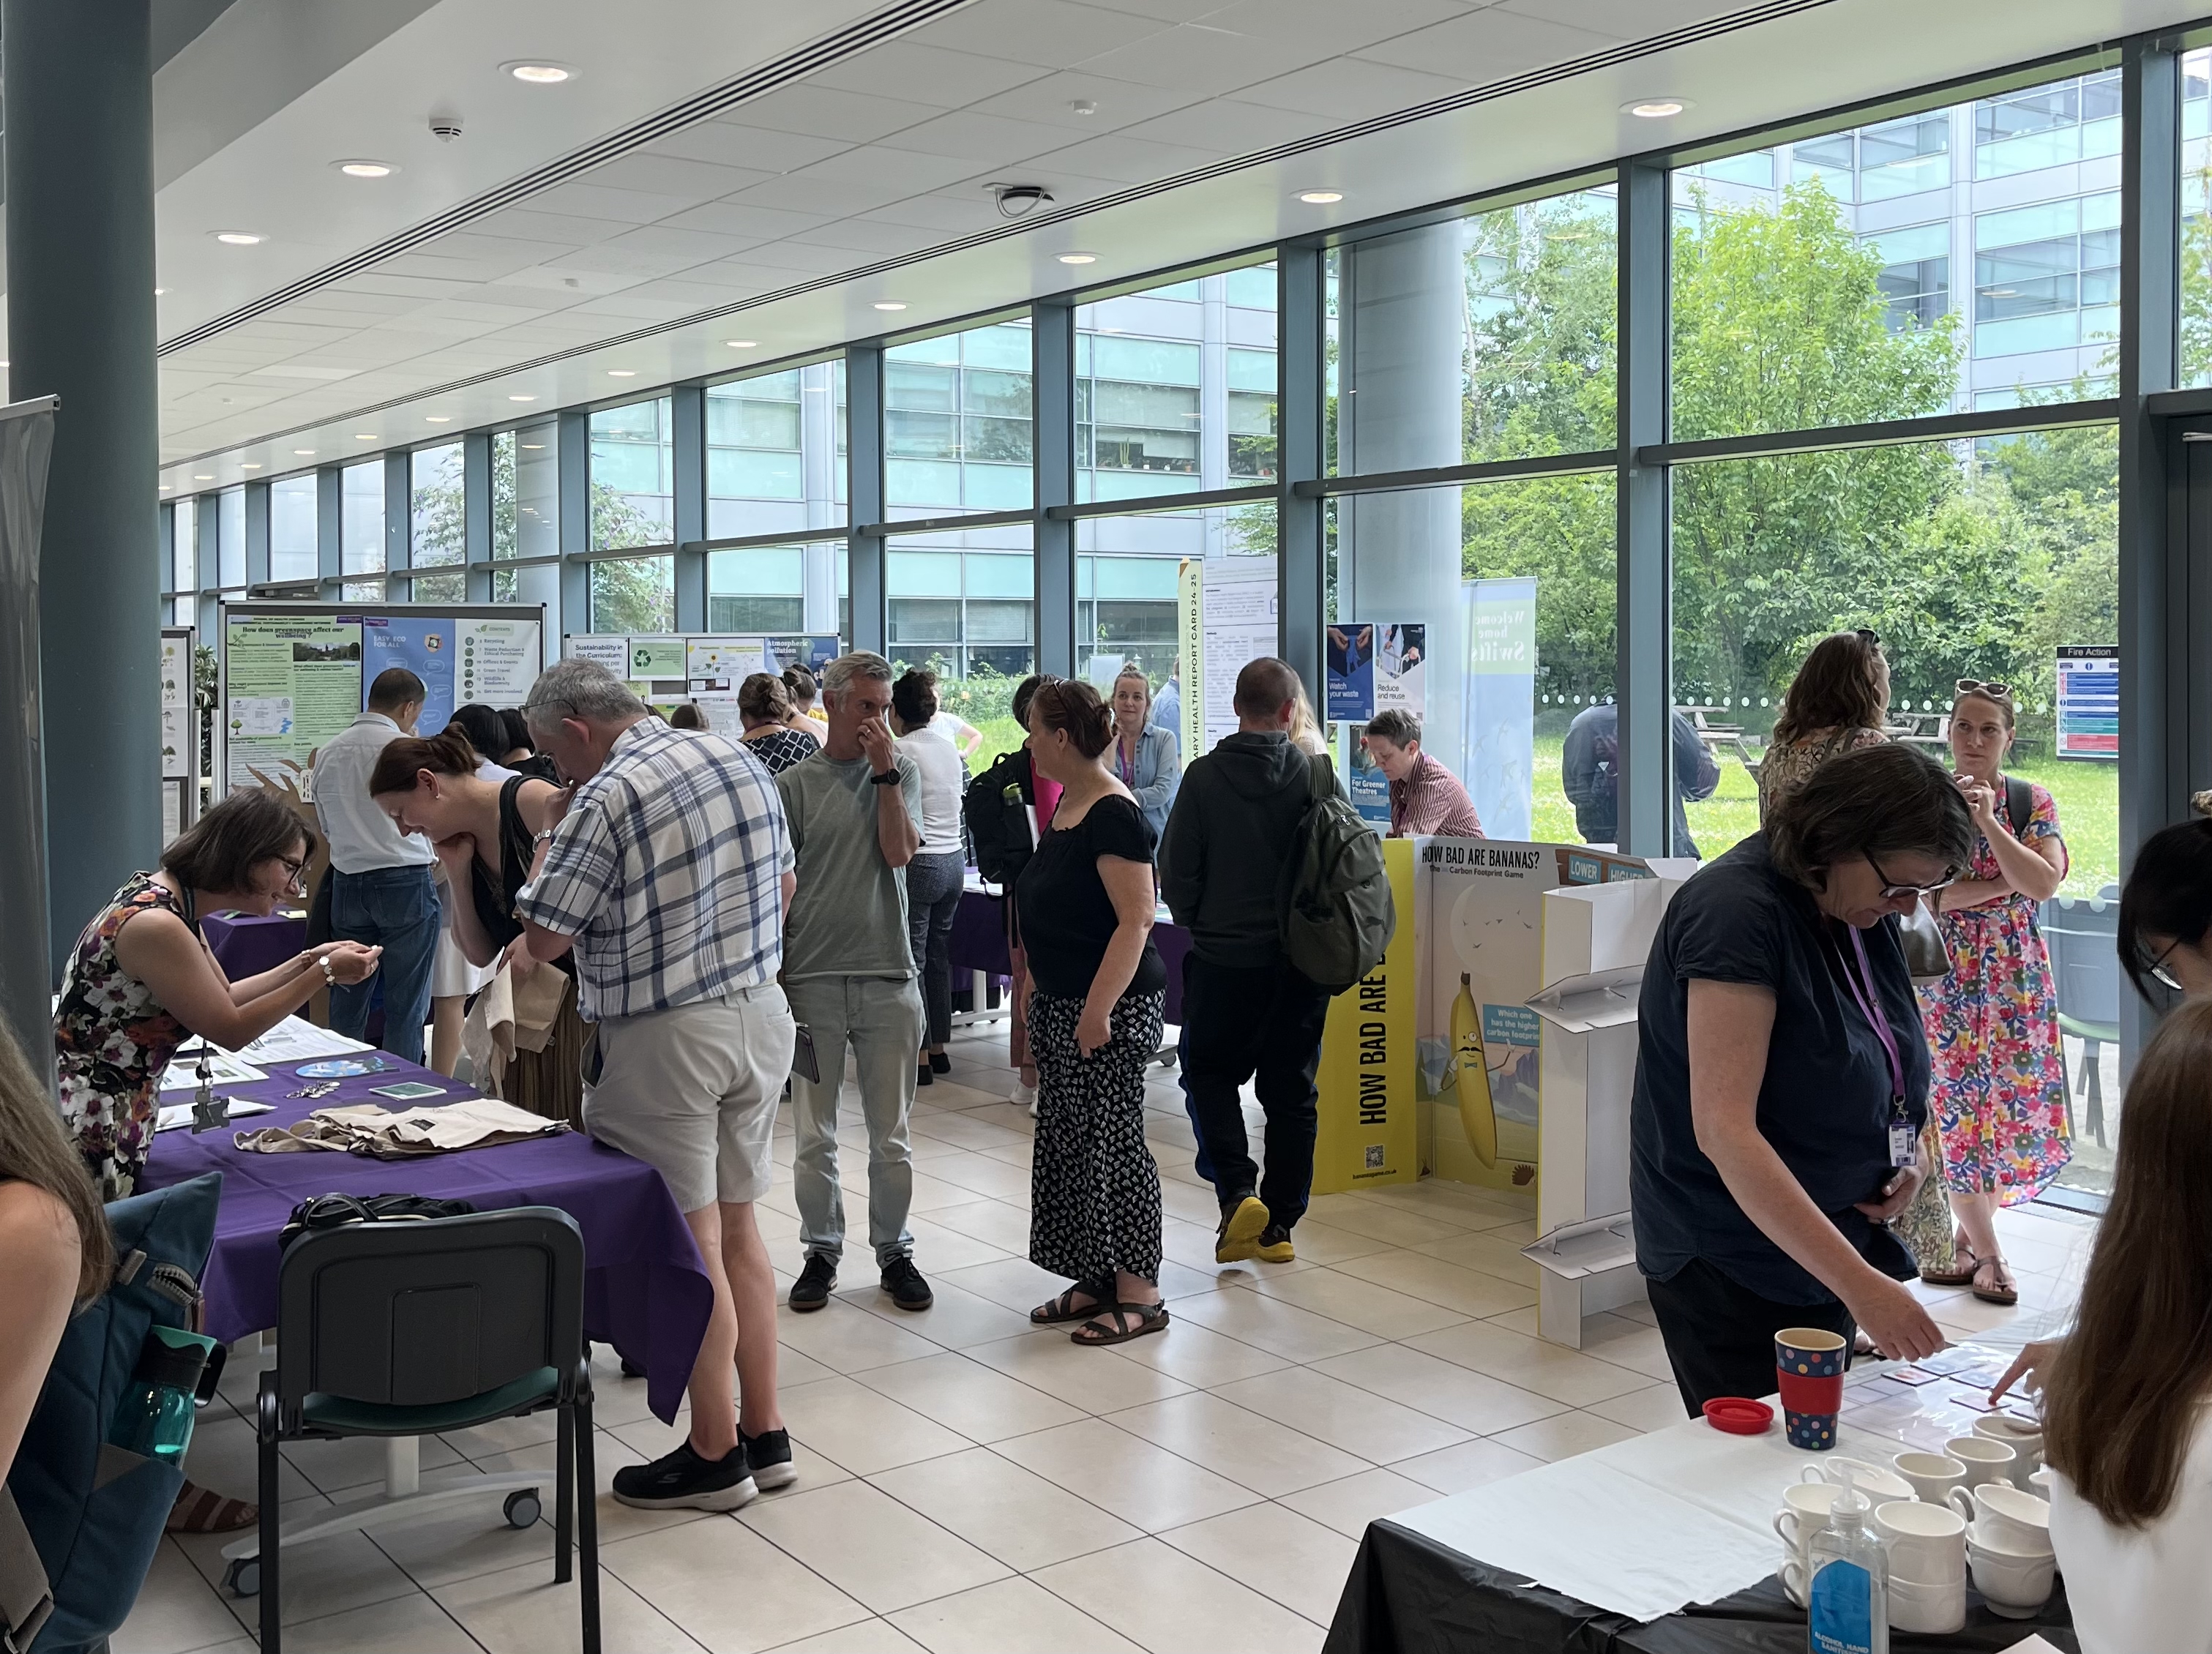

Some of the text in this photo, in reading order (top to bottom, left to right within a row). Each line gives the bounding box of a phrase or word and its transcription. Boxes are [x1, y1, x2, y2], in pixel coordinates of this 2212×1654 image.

[767, 640, 809, 648] Atmospheric
[766, 647, 796, 655] pollution
[2068, 648, 2112, 656] Fire Action
[1362, 780, 1386, 789] Greener
[1352, 787, 1378, 796] Theatres
[1422, 846, 1540, 869] HOW BAD ARE BANANAS?
[1449, 867, 1473, 875] Carbon
[1474, 868, 1503, 877] Footprint
[1504, 870, 1524, 878] Game
[1571, 860, 1597, 880] LOWER
[1359, 974, 1386, 1013] ARE
[1498, 1009, 1518, 1018] Which
[1491, 1018, 1539, 1031] has the higher
[1487, 1029, 1539, 1040] carbon footprin
[1359, 1022, 1386, 1065] BAD
[1359, 1074, 1386, 1124] HOW
[1847, 1644, 1869, 1654] HAND
